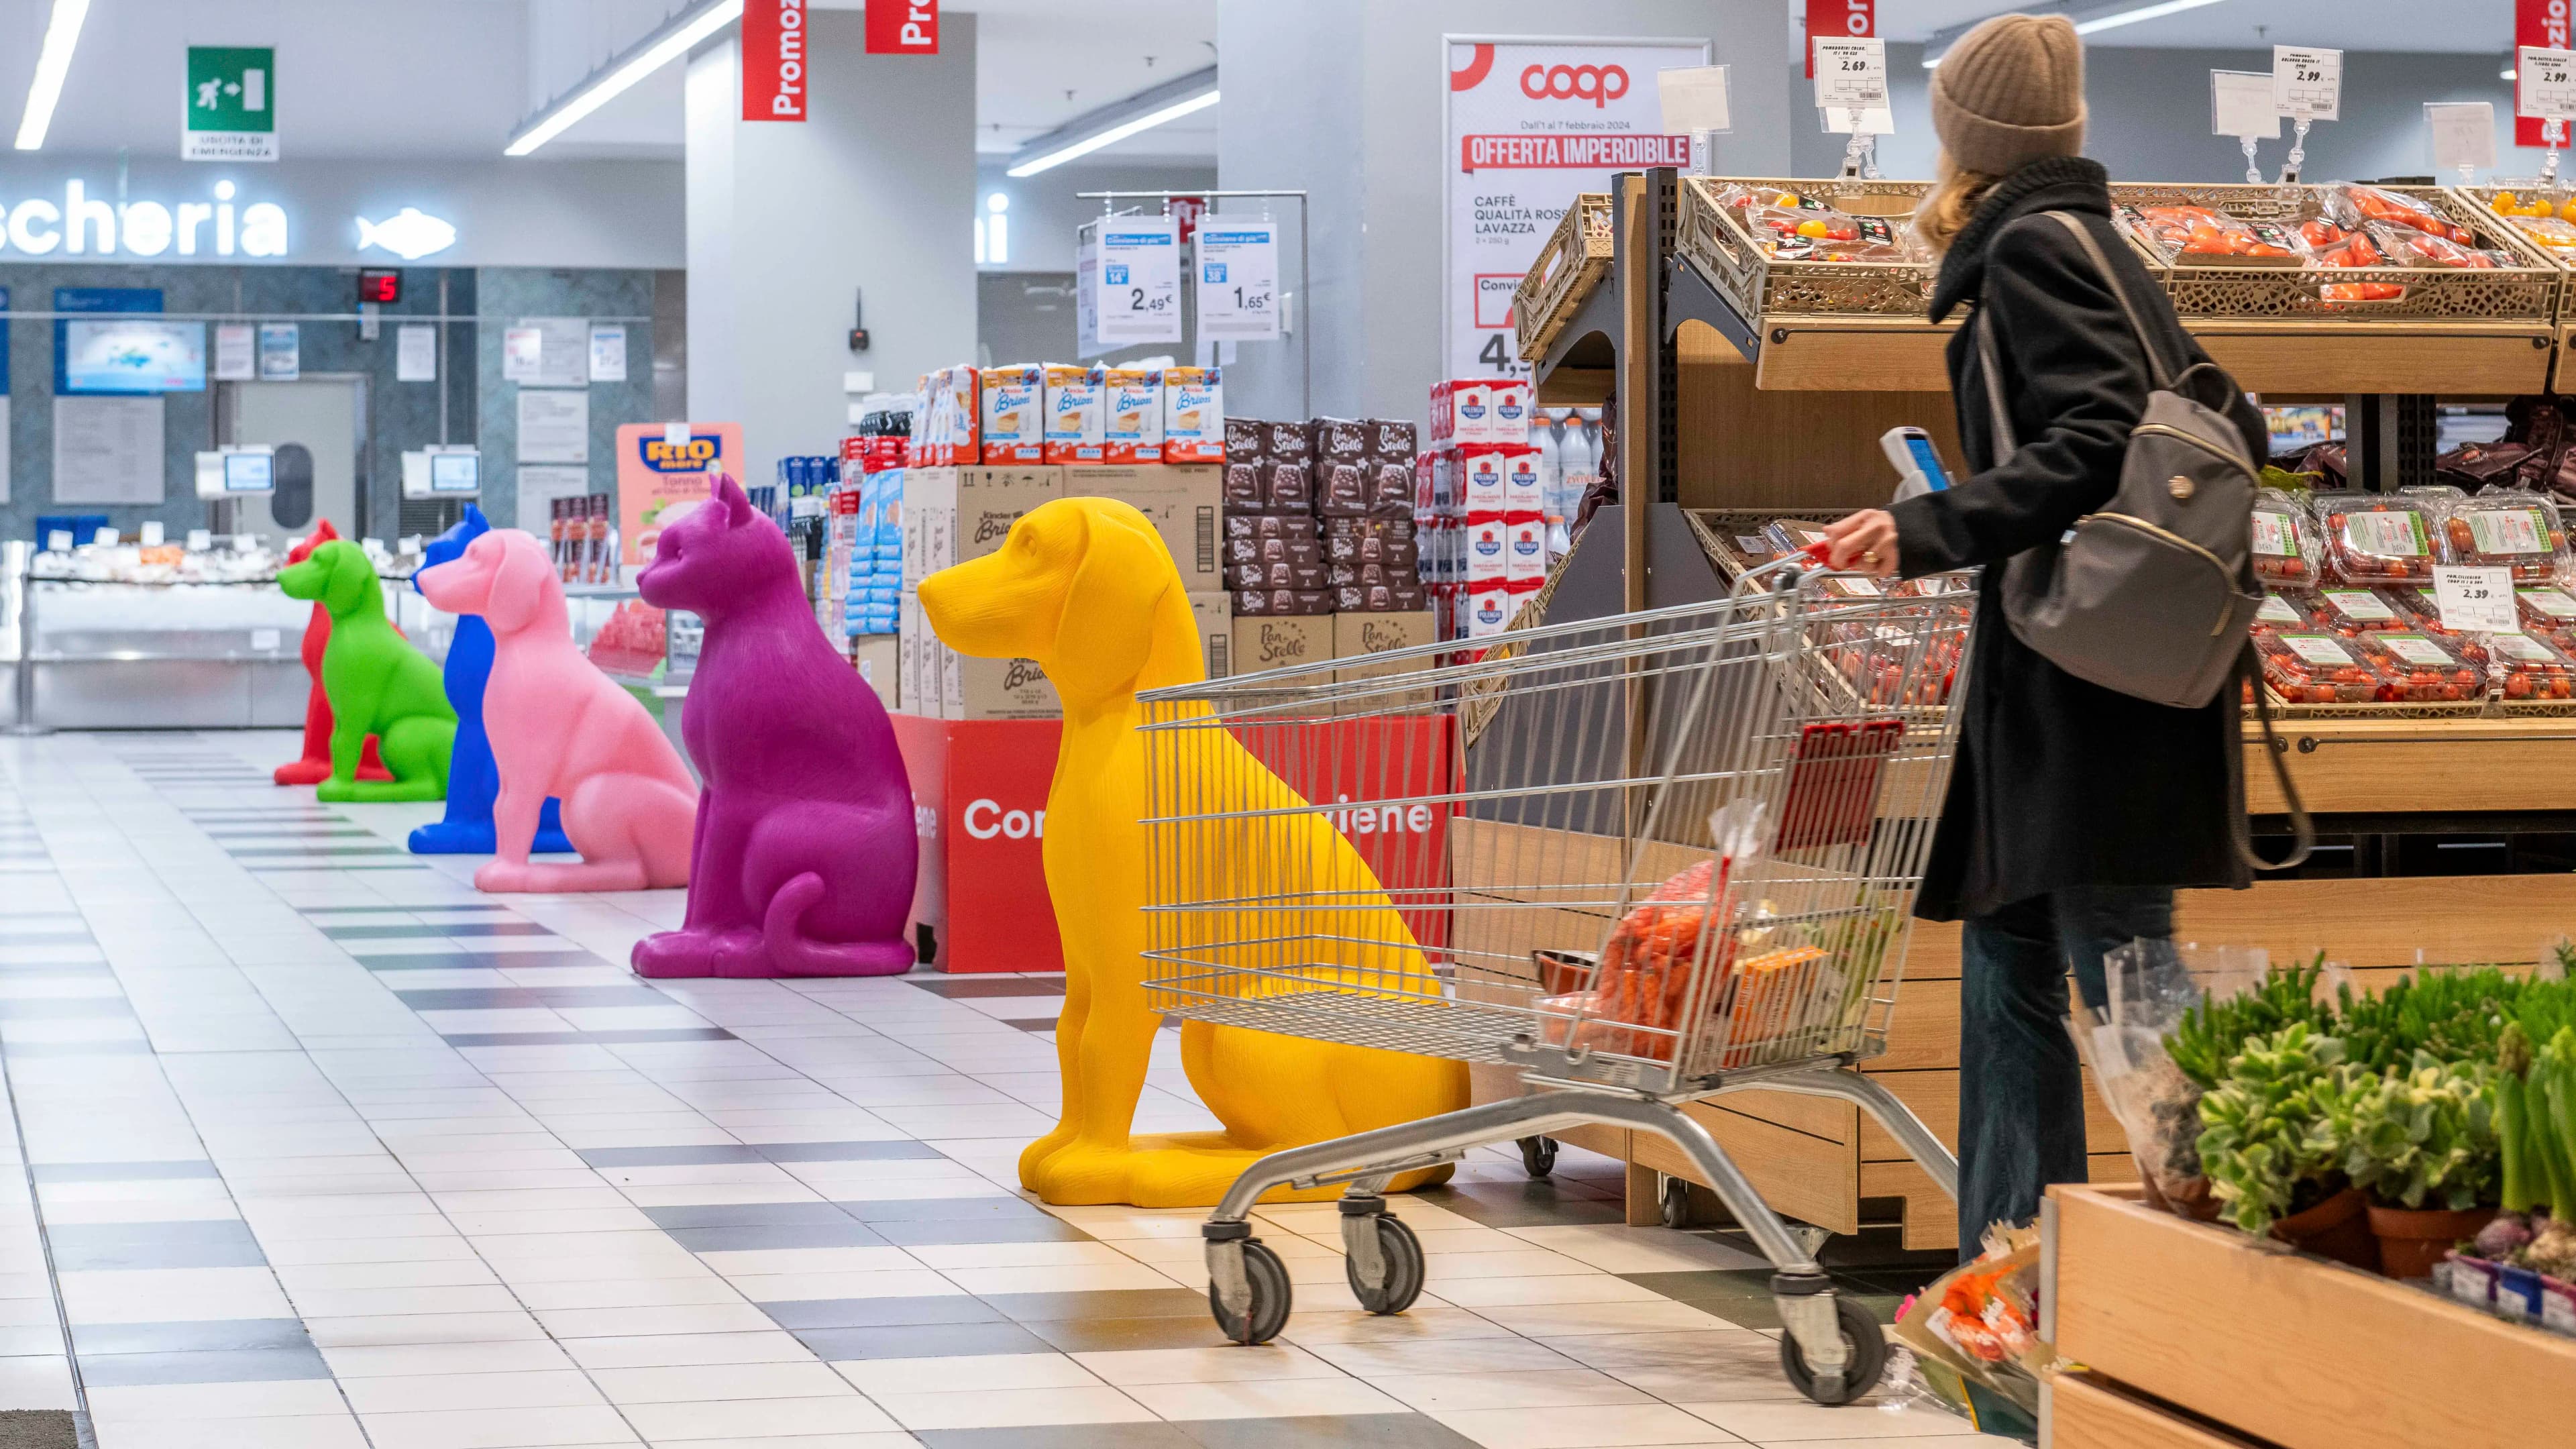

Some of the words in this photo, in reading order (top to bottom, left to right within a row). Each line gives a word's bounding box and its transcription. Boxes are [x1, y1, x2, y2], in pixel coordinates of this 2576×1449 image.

[1520, 64, 1629, 109] coop
[1548, 121, 1556, 129] al
[1558, 121, 1564, 129] 7
[1566, 120, 1605, 129] febbraio
[1607, 121, 1631, 129] 2024
[1471, 138, 1560, 164] OFFERTA
[1564, 138, 1687, 164] IMPERDIBILE
[1474, 194, 1516, 207] CAFFÈ
[0, 178, 288, 257] cheria
[1474, 207, 1532, 221] QUALITÀ
[1536, 209, 1567, 220] ROSS
[1475, 223, 1536, 233] LAVAZZA
[378, 276, 396, 301] 5
[1481, 280, 1521, 290] Convi
[646, 439, 715, 461] RIO
[1226, 439, 1258, 453] Stelle
[1273, 438, 1305, 453] Stelle
[1330, 438, 1363, 454] Stelle
[1378, 438, 1411, 454] Stelle
[975, 520, 1011, 544] Brio
[1260, 623, 1283, 645] Pan
[1362, 622, 1385, 642] Pan
[1259, 640, 1305, 661] Stelle
[1004, 664, 1048, 690] Brio
